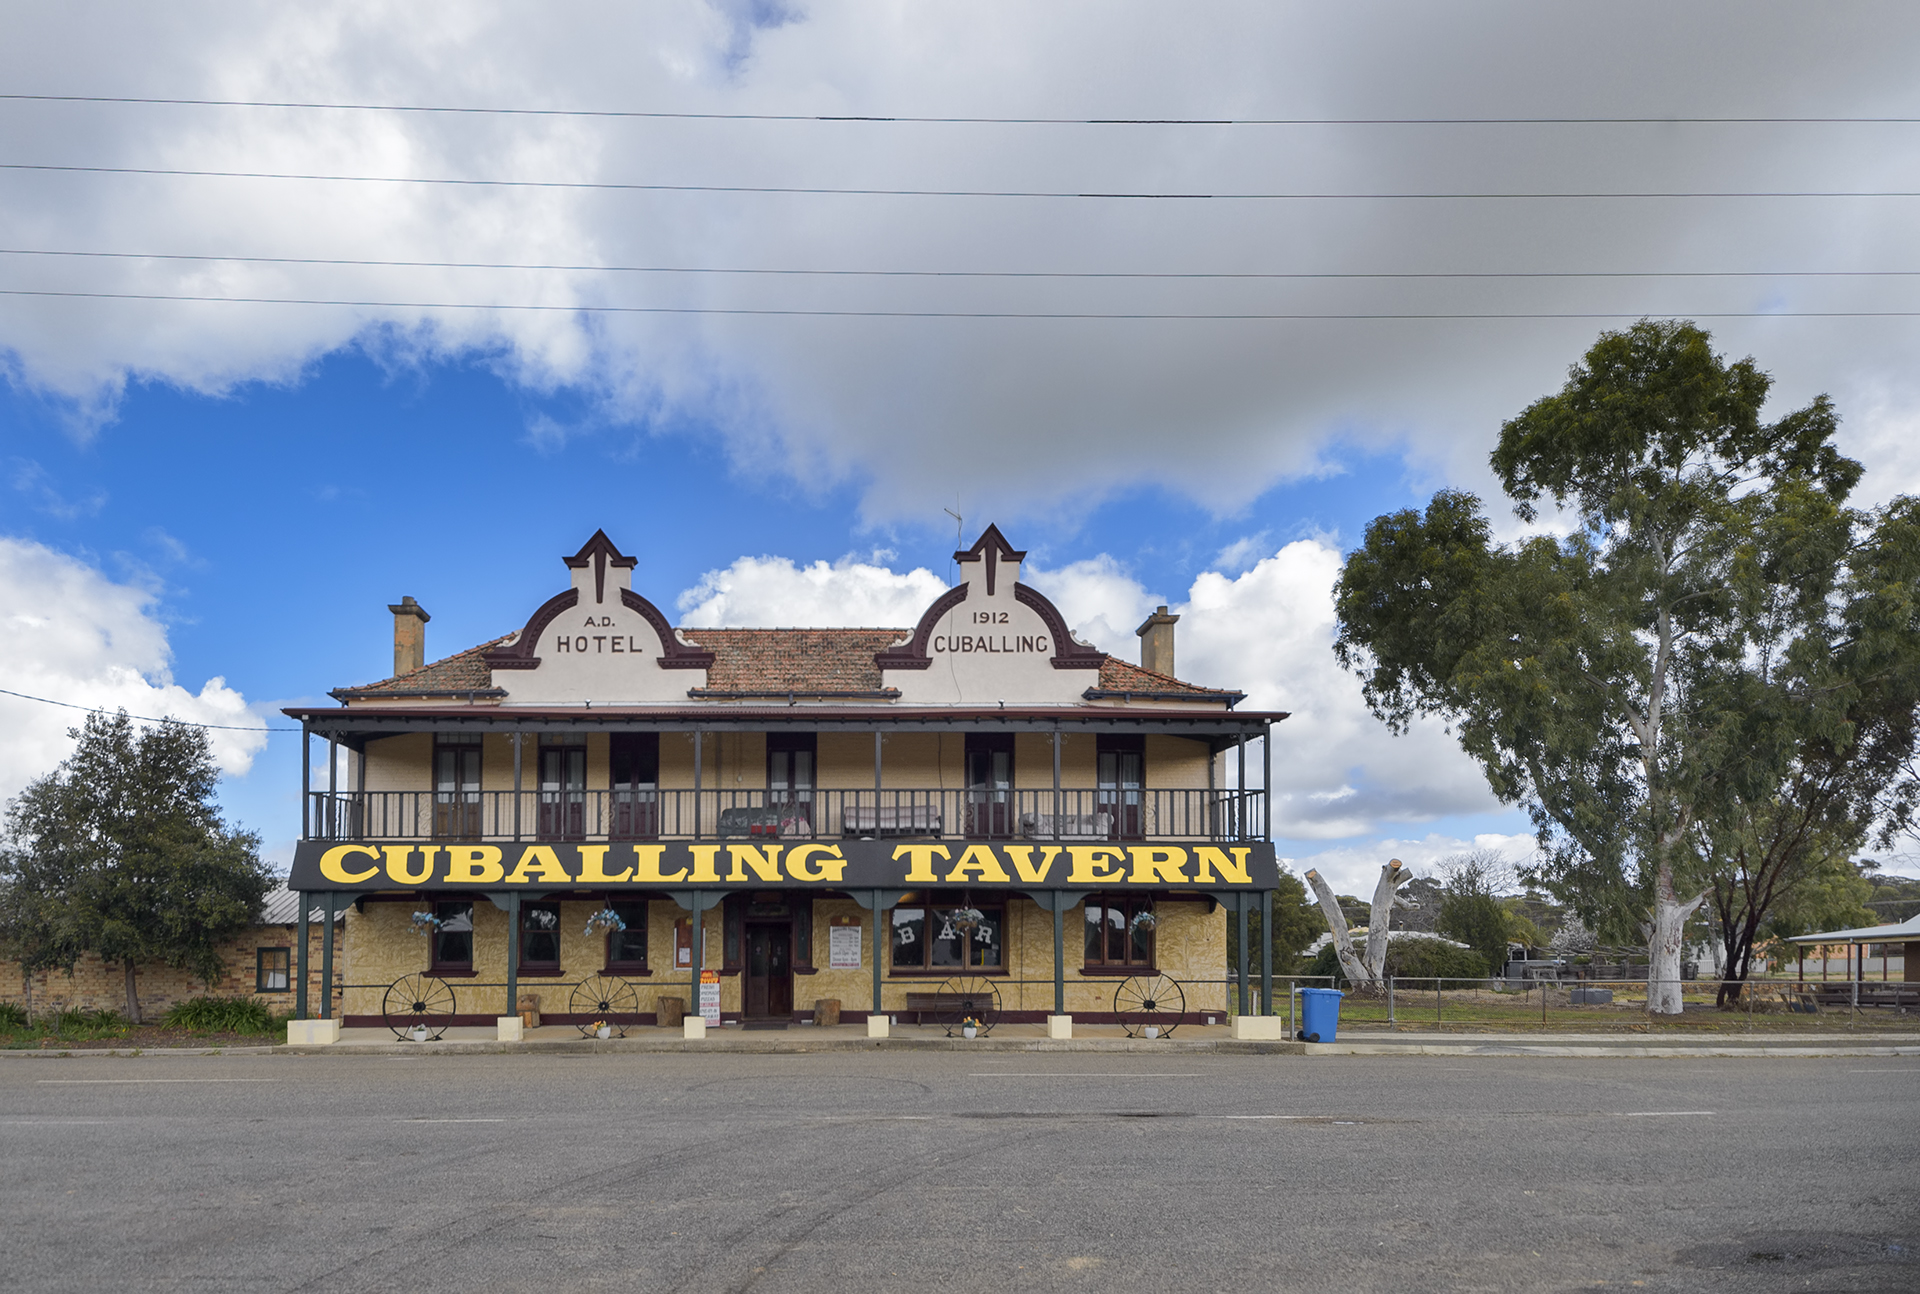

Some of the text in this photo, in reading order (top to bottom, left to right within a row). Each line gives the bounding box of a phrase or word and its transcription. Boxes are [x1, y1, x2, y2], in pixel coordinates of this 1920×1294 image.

[584, 616, 616, 627] A.D.
[973, 611, 1009, 624] 1912
[557, 635, 643, 653] HOTEL
[934, 635, 1048, 653] CUBALLING
[320, 844, 1252, 884] CUBALLING TAVERN
[898, 921, 992, 945] BAR
